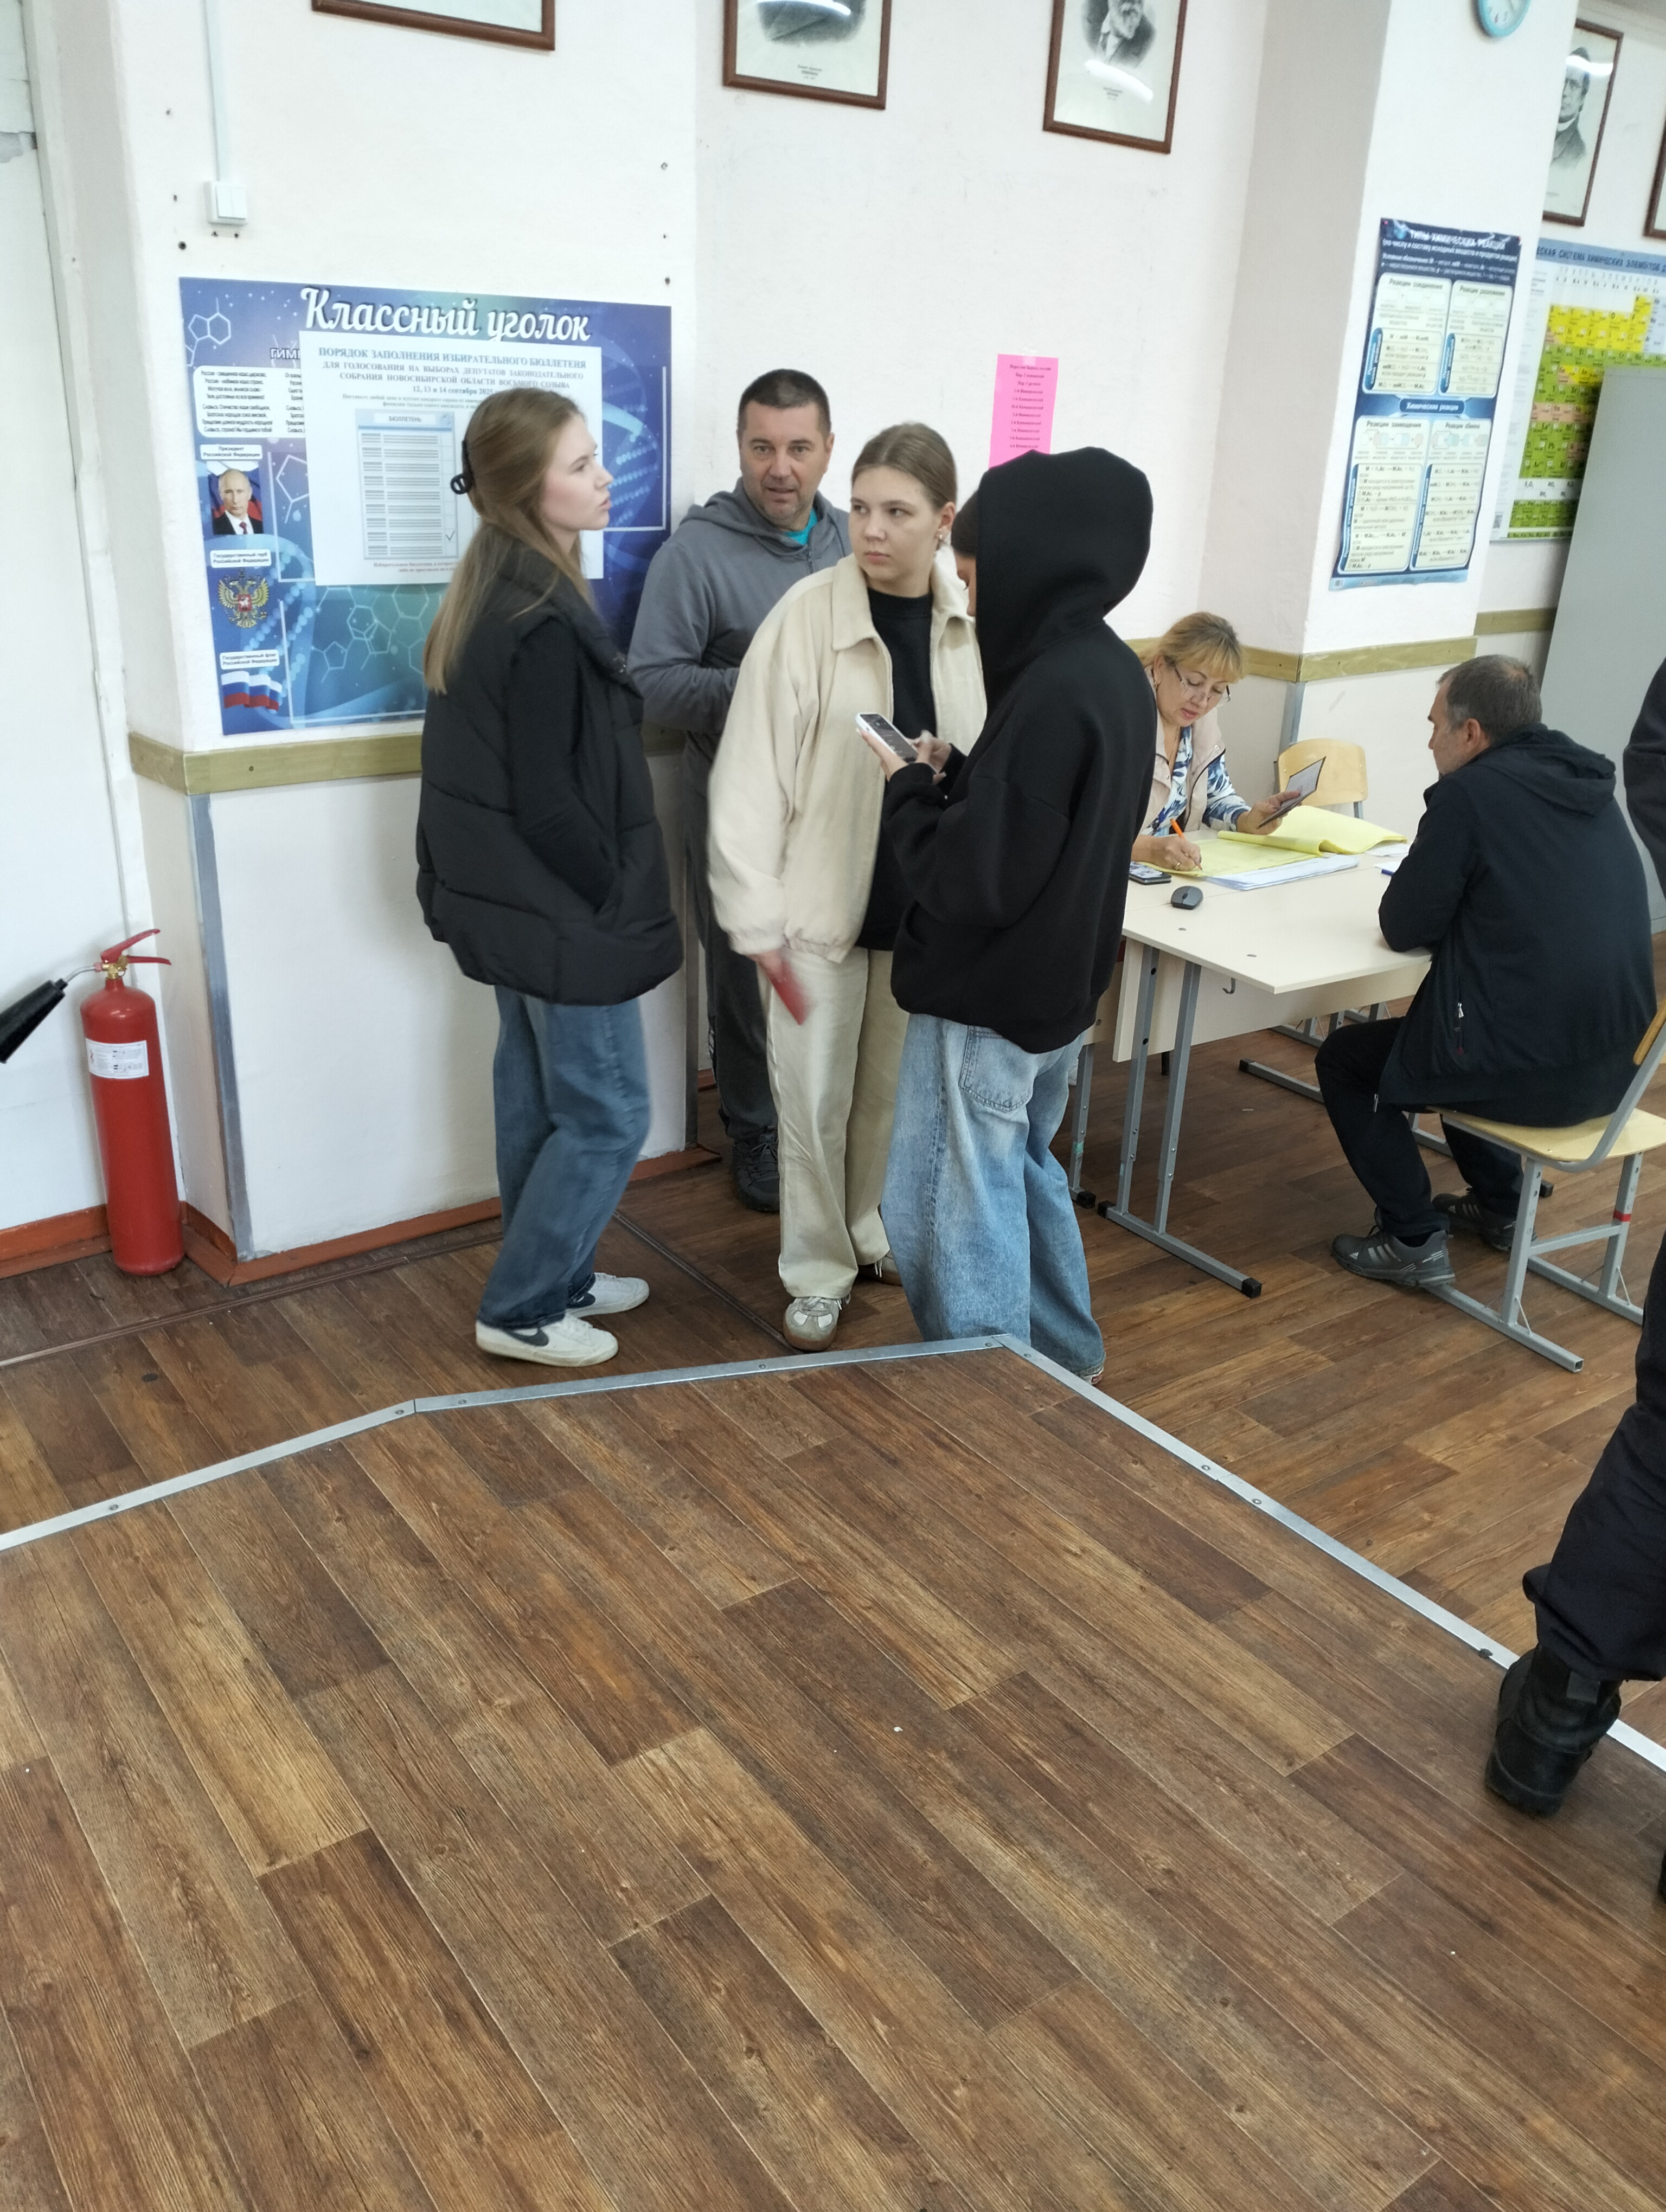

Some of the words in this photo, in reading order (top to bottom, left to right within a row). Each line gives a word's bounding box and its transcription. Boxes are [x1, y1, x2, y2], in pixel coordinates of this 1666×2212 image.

[1536, 246, 1556, 256] ЕСКАЯ
[1559, 250, 1585, 261] СИСТЕМА
[301, 287, 480, 336] Классный
[488, 311, 591, 342] уголок
[270, 348, 300, 360] ГИМ
[319, 348, 368, 357] ПОРЯДОК
[371, 350, 440, 361] ЗАПОЛНЕНИЯ
[443, 353, 527, 365] ИЗБИРАТЕЛЬНОГО
[530, 357, 586, 369] БЮЛЛЕТЕНЯ
[344, 362, 405, 371] ГОЛОСОВАНИЯ
[424, 365, 459, 374] ВЫБОРАХ
[463, 368, 506, 376] ДЕПУТАТОВ
[509, 370, 584, 380] ЗАКОНОДАТЕЛЬНОГО
[387, 374, 457, 384] НОВОСИБИРСКОЙ
[460, 377, 495, 385] ОБЛАСТИ
